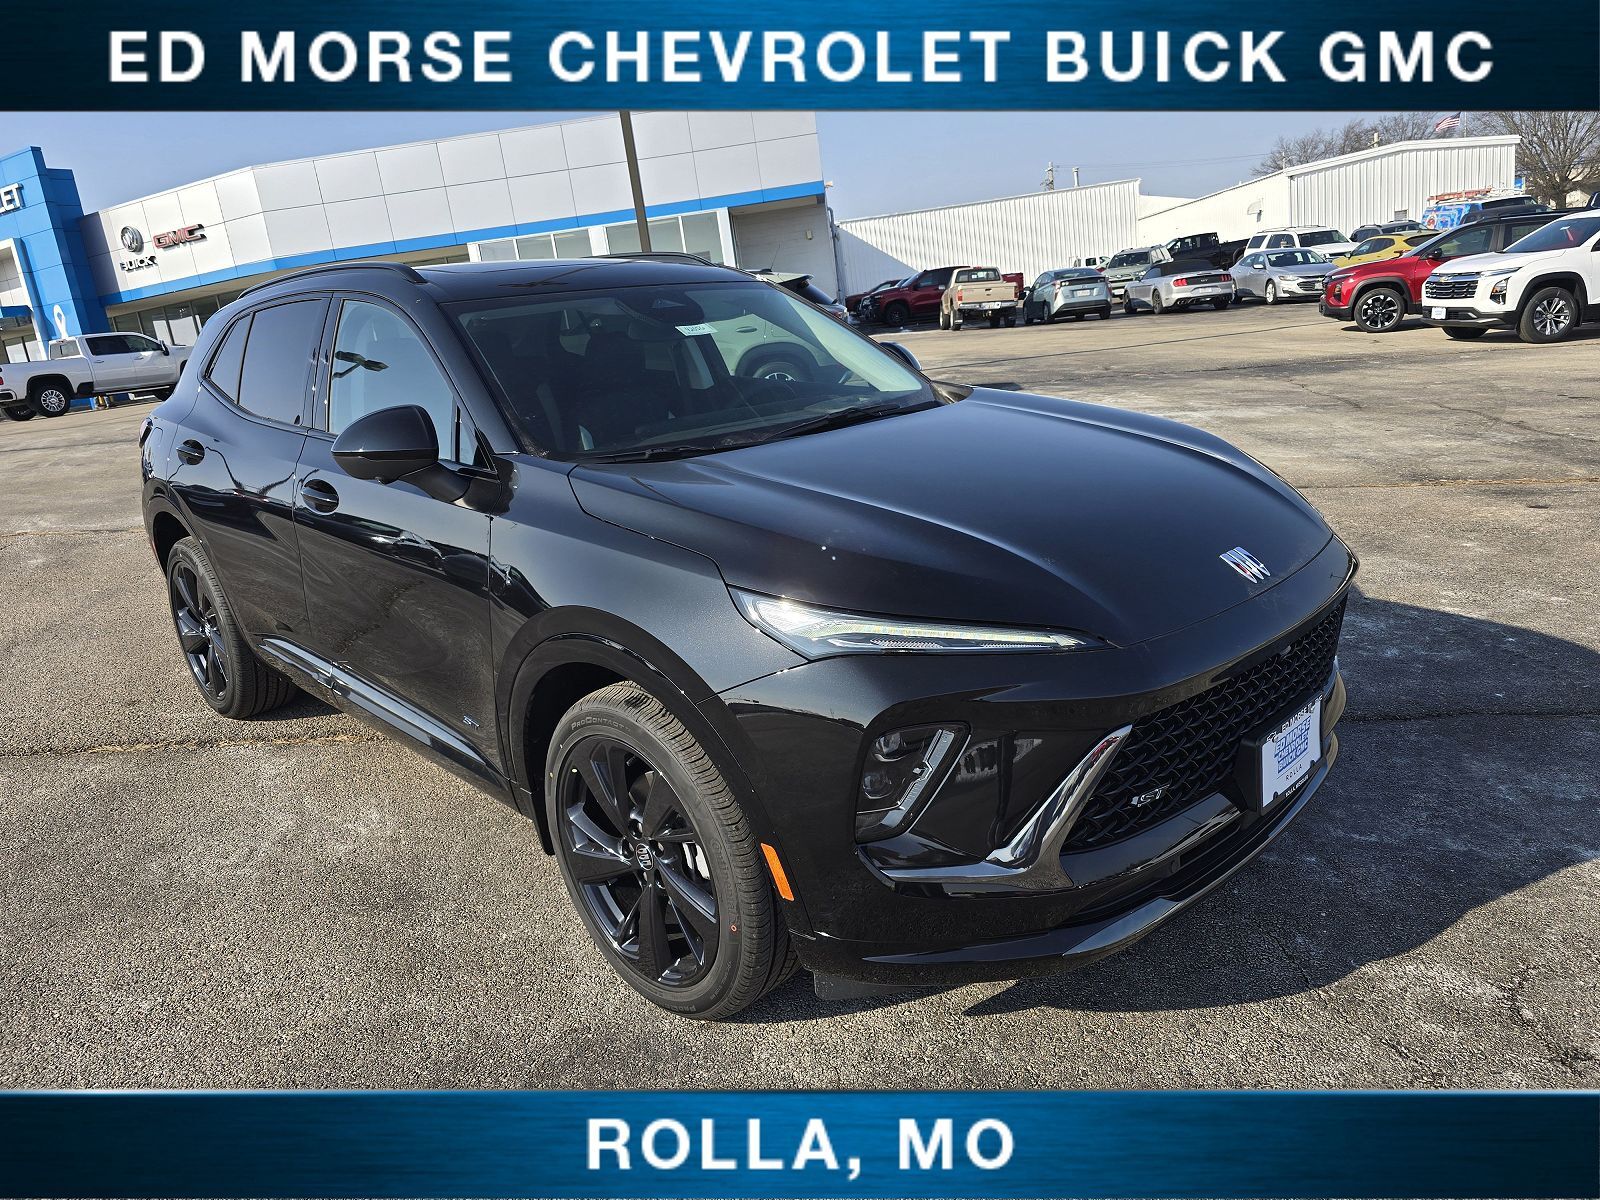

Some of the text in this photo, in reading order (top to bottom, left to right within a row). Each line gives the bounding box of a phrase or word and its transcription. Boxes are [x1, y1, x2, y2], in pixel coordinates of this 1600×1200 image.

[153, 224, 207, 248] GMC
[120, 256, 157, 271] BUICK
[1286, 763, 1302, 781] ROLLA
